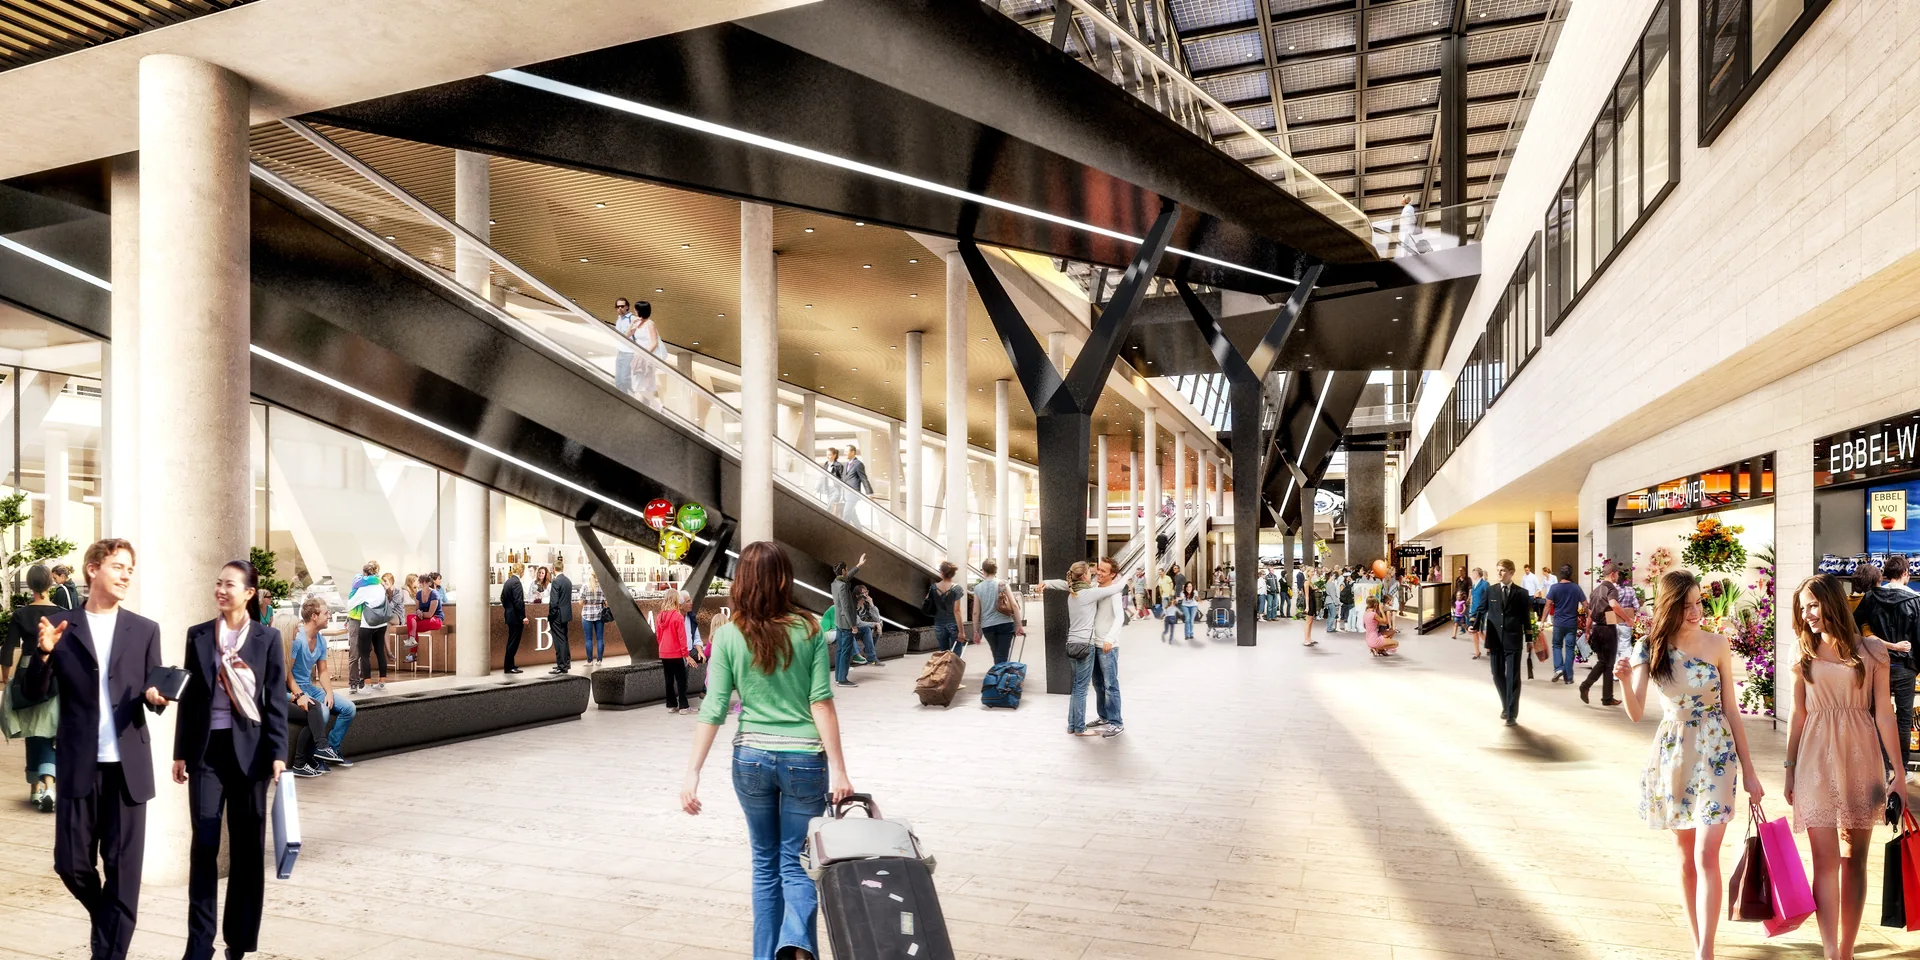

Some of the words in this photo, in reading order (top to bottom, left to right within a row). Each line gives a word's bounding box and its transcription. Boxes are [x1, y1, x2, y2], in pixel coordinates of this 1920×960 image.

[1830, 423, 1918, 474] EBBELW
[1638, 489, 1670, 513] FLOWER
[1672, 479, 1706, 507] POWER
[1874, 492, 1902, 501] EBBEL
[1878, 505, 1898, 513] WOI
